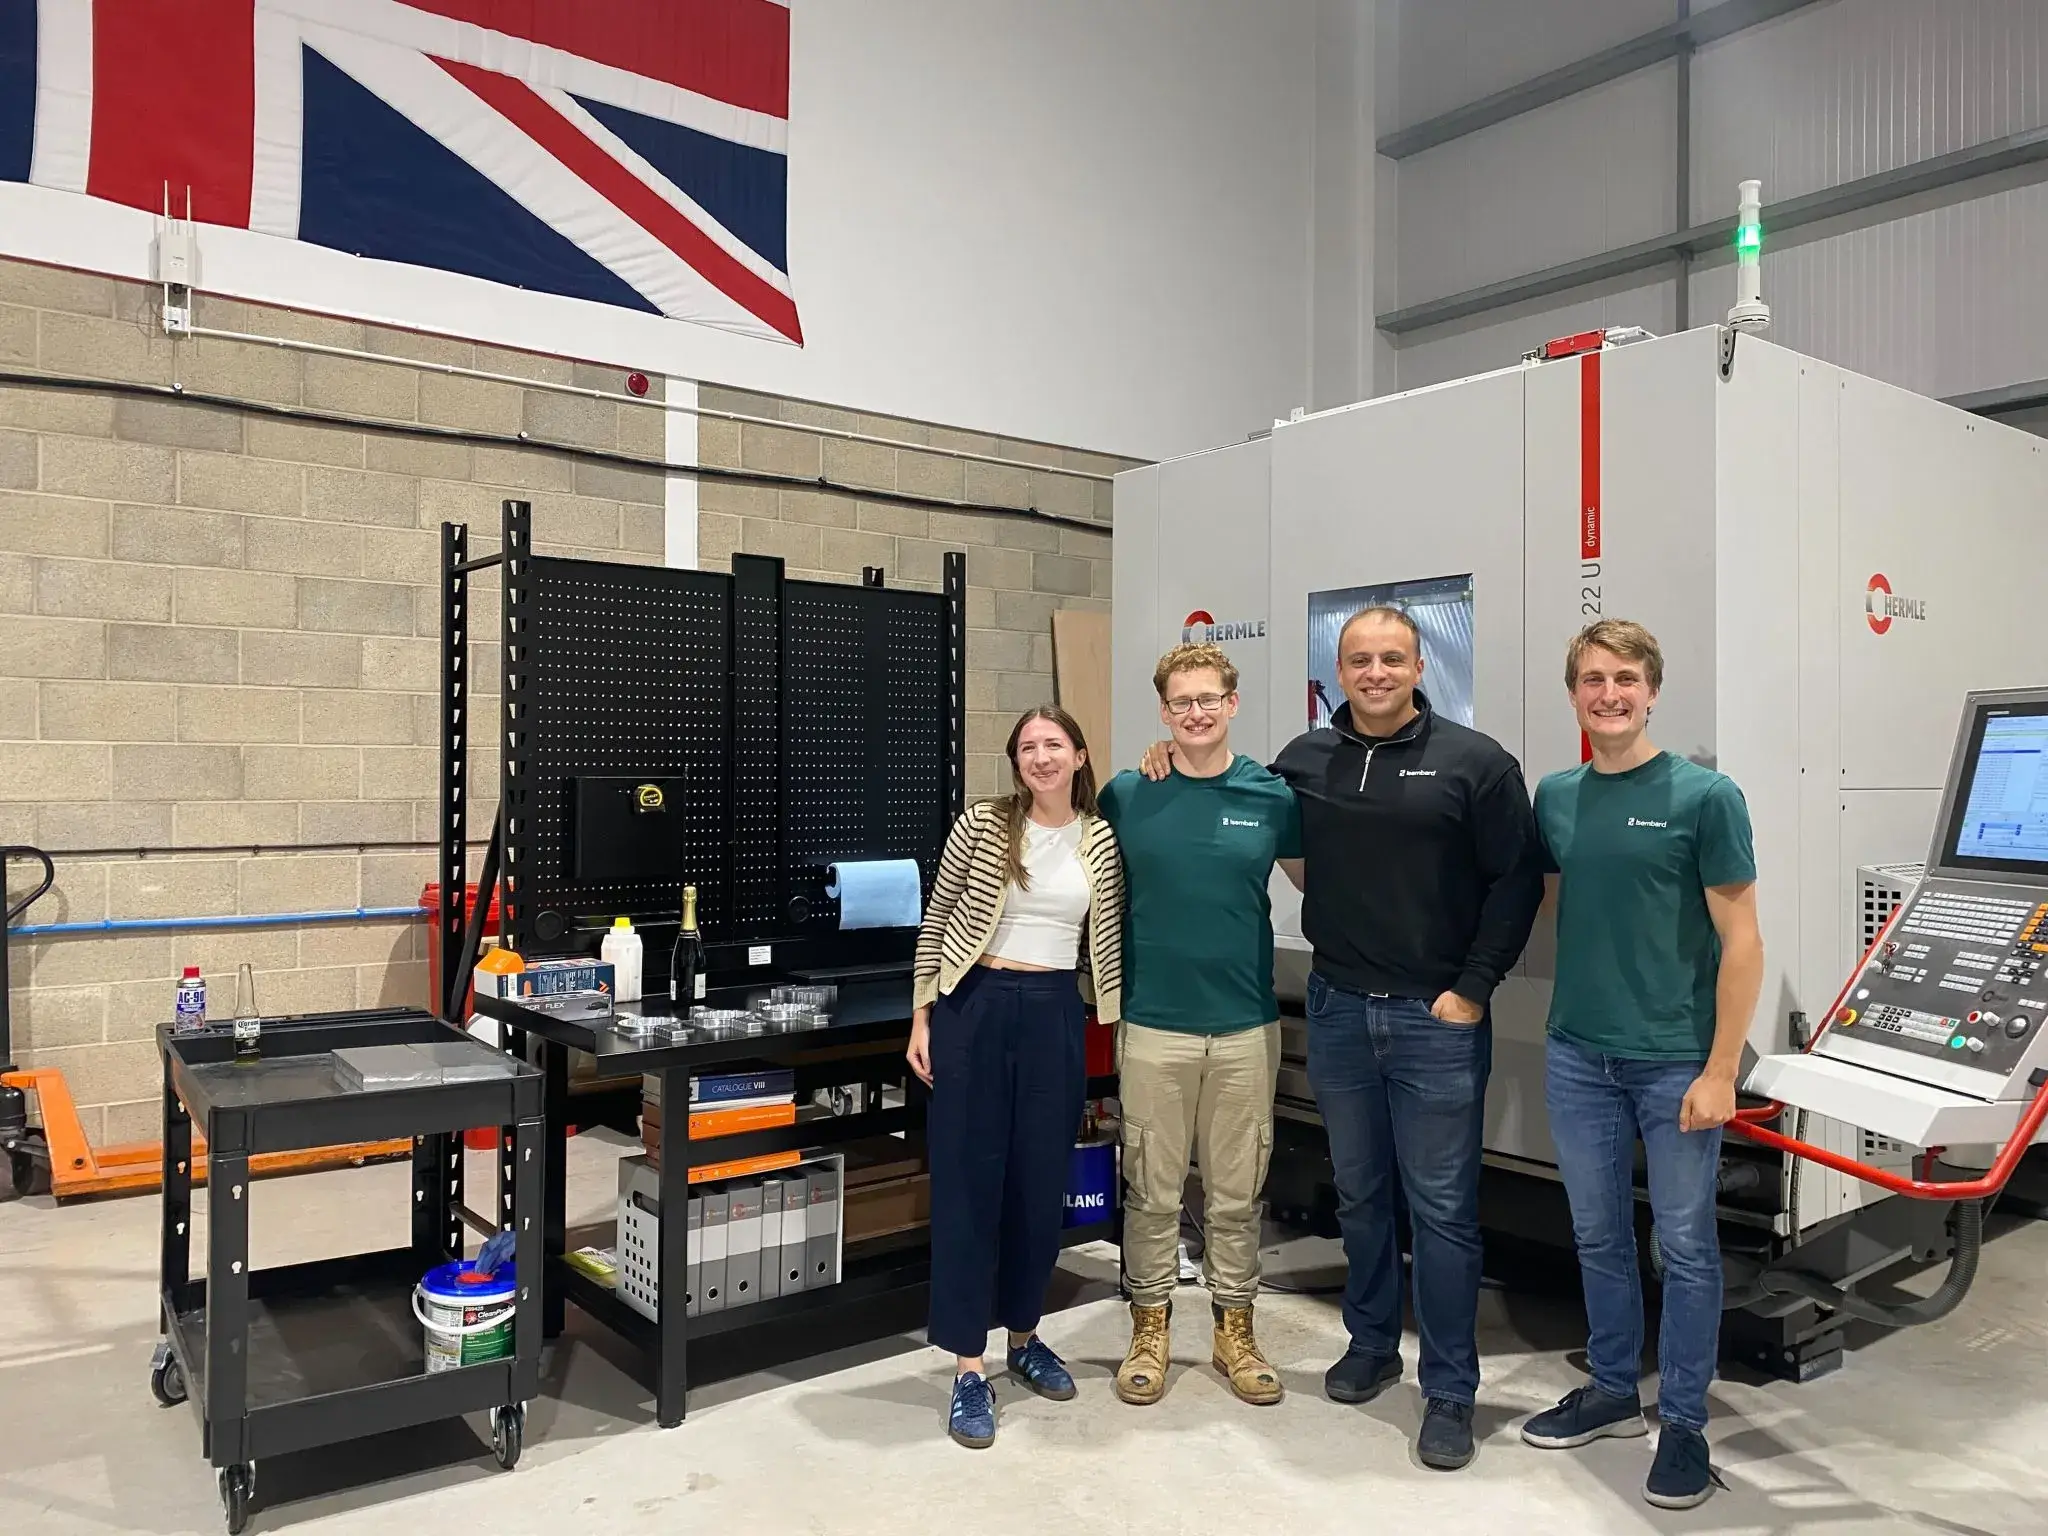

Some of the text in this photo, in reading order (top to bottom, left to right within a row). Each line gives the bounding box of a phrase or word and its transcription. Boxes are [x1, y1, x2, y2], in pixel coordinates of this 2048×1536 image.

[1584, 506, 1597, 547] dynamic
[1885, 595, 1926, 620] HERMLE
[1205, 621, 1266, 641] HERMLE
[178, 991, 205, 1003] AC-90
[712, 1081, 766, 1093] CATALOGUE VIII
